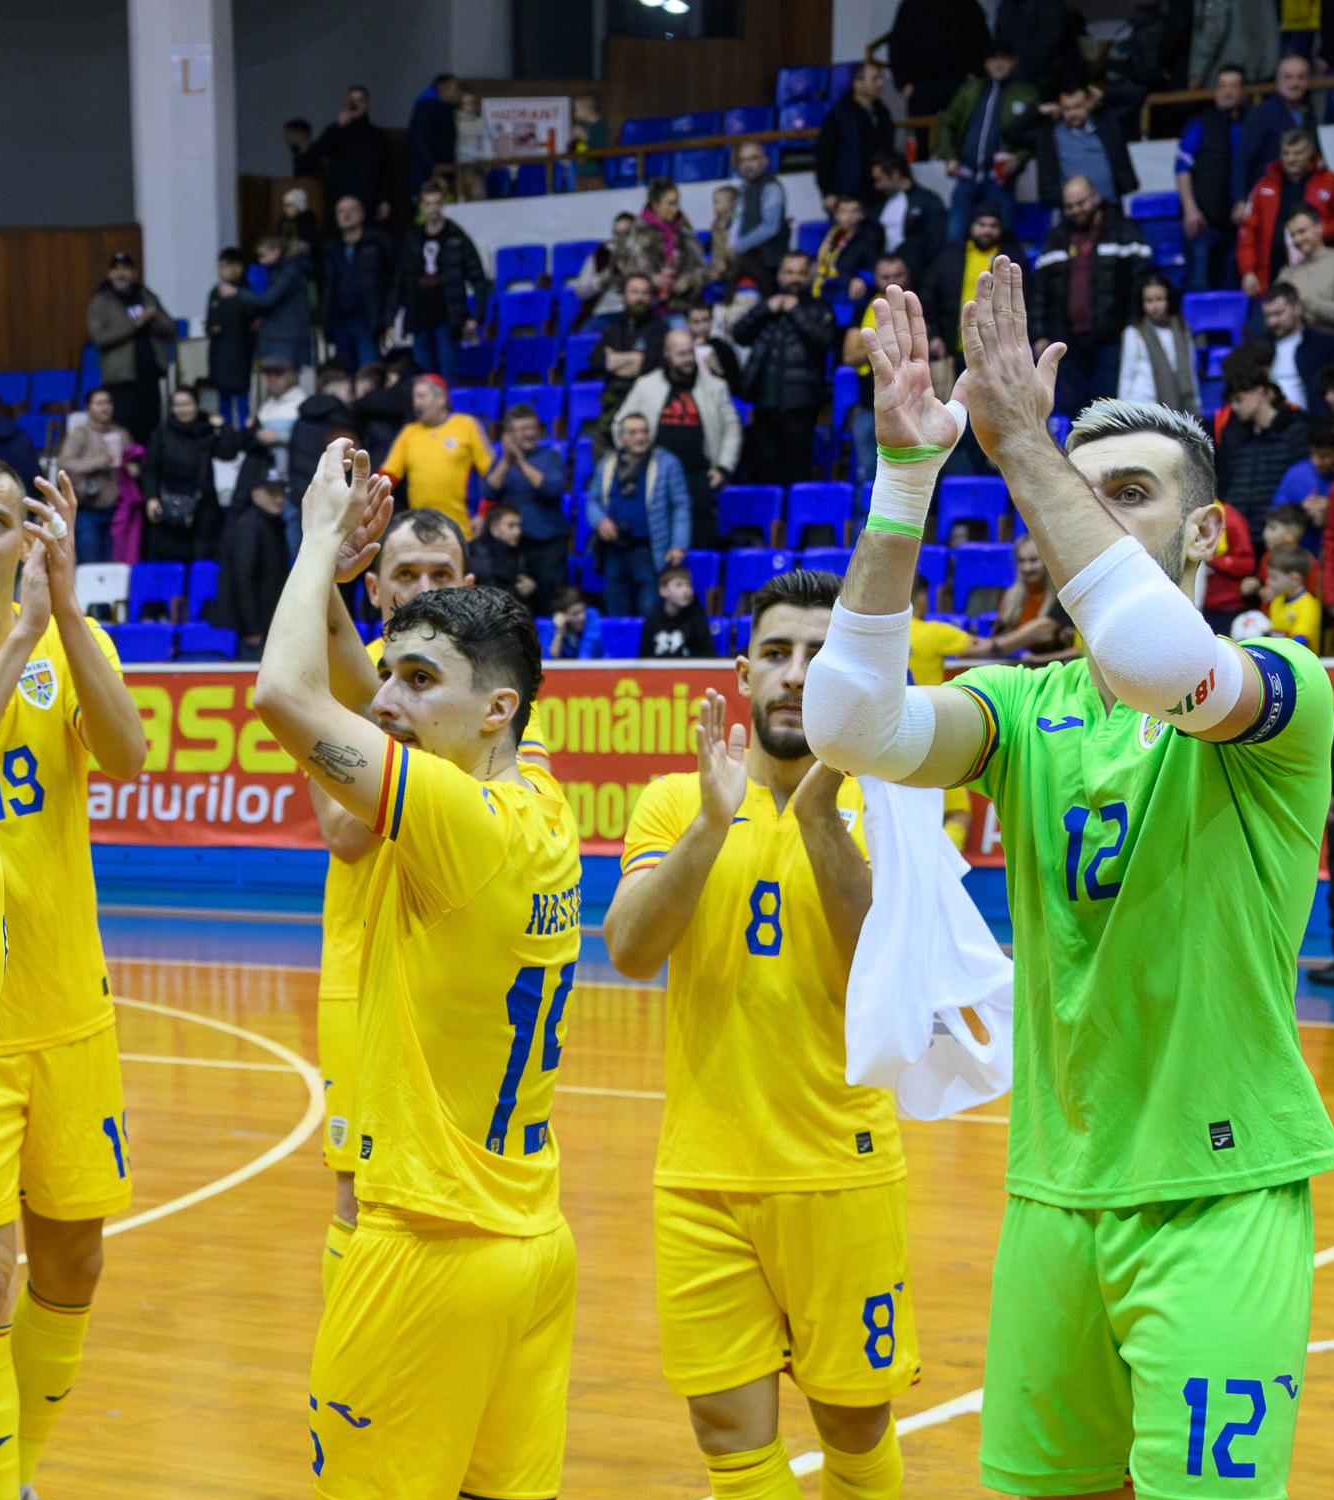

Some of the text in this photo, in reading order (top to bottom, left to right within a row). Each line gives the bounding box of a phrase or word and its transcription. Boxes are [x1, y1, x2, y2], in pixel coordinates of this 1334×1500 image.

[540, 677, 707, 754] omâni
[1063, 800, 1129, 902] 12
[745, 879, 783, 957] 8
[862, 1291, 896, 1370] 8
[1182, 1376, 1267, 1479] 12
